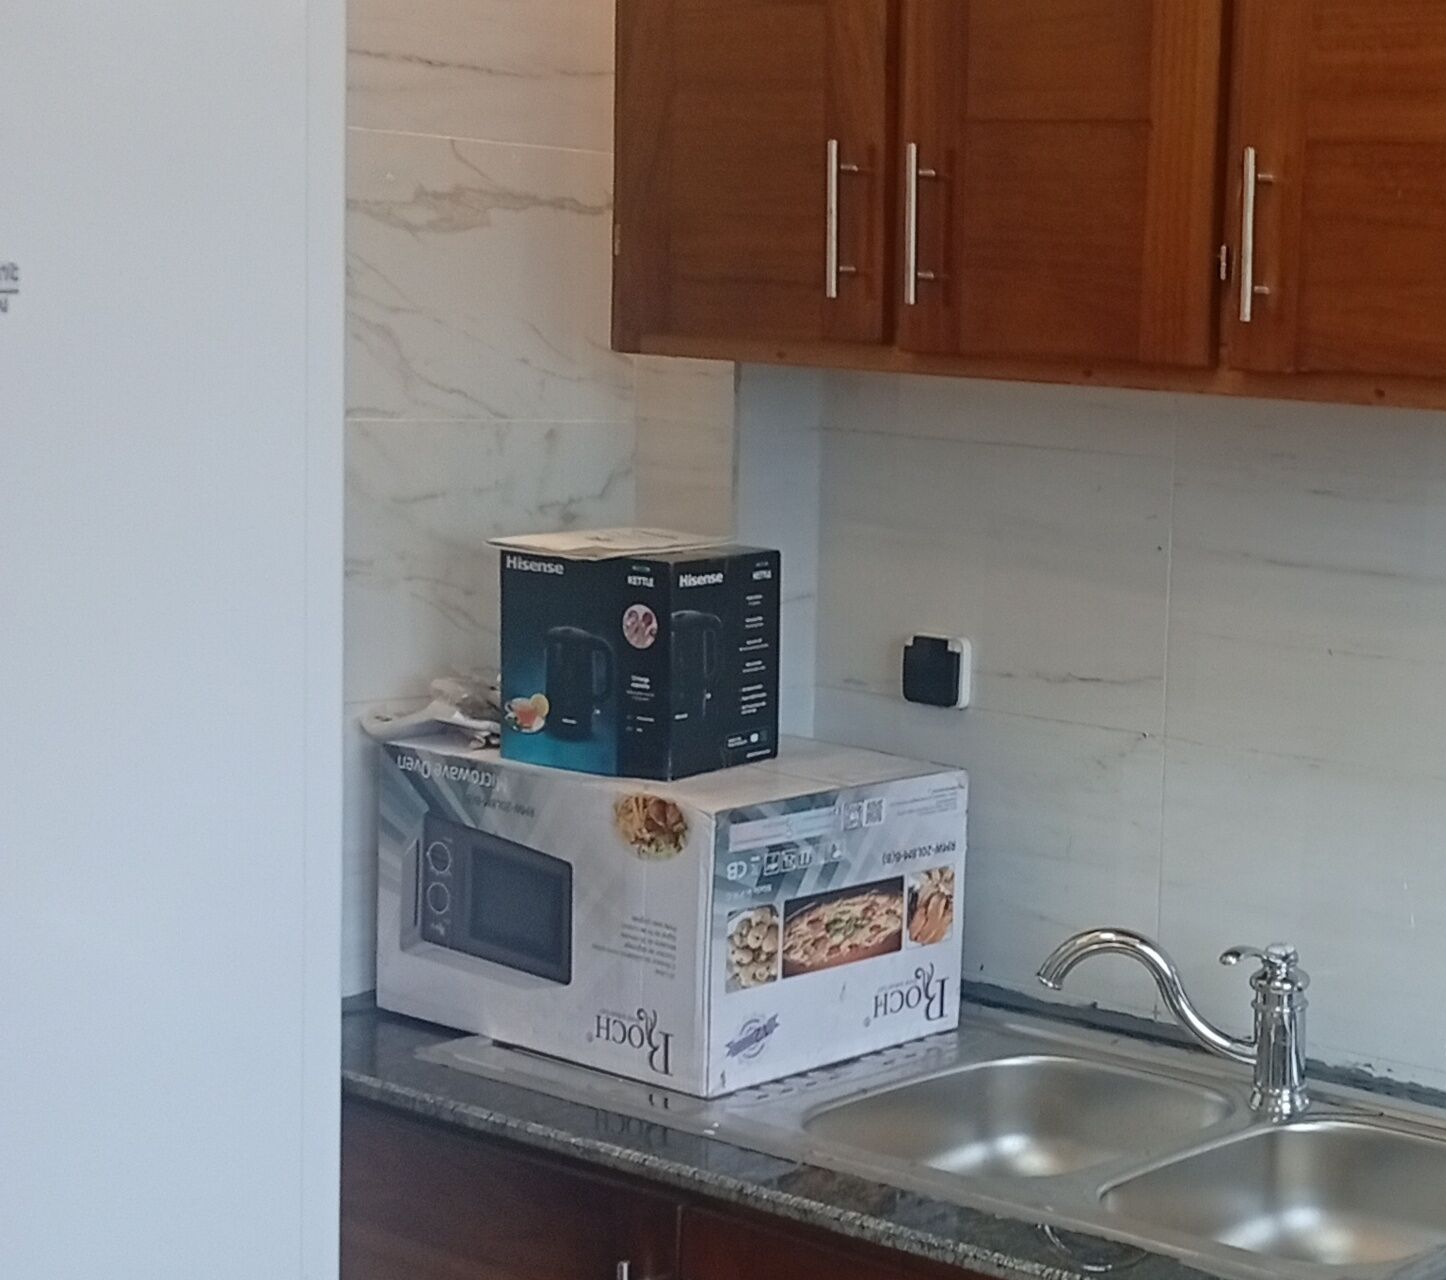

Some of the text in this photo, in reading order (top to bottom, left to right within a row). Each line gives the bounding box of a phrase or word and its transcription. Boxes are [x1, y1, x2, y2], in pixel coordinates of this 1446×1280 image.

[505, 554, 564, 575] Hisense
[679, 572, 724, 588] Hisense
[396, 754, 508, 793] Microwave Oven
[873, 963, 949, 1021] ROCH
[595, 1008, 675, 1077] ROCH
